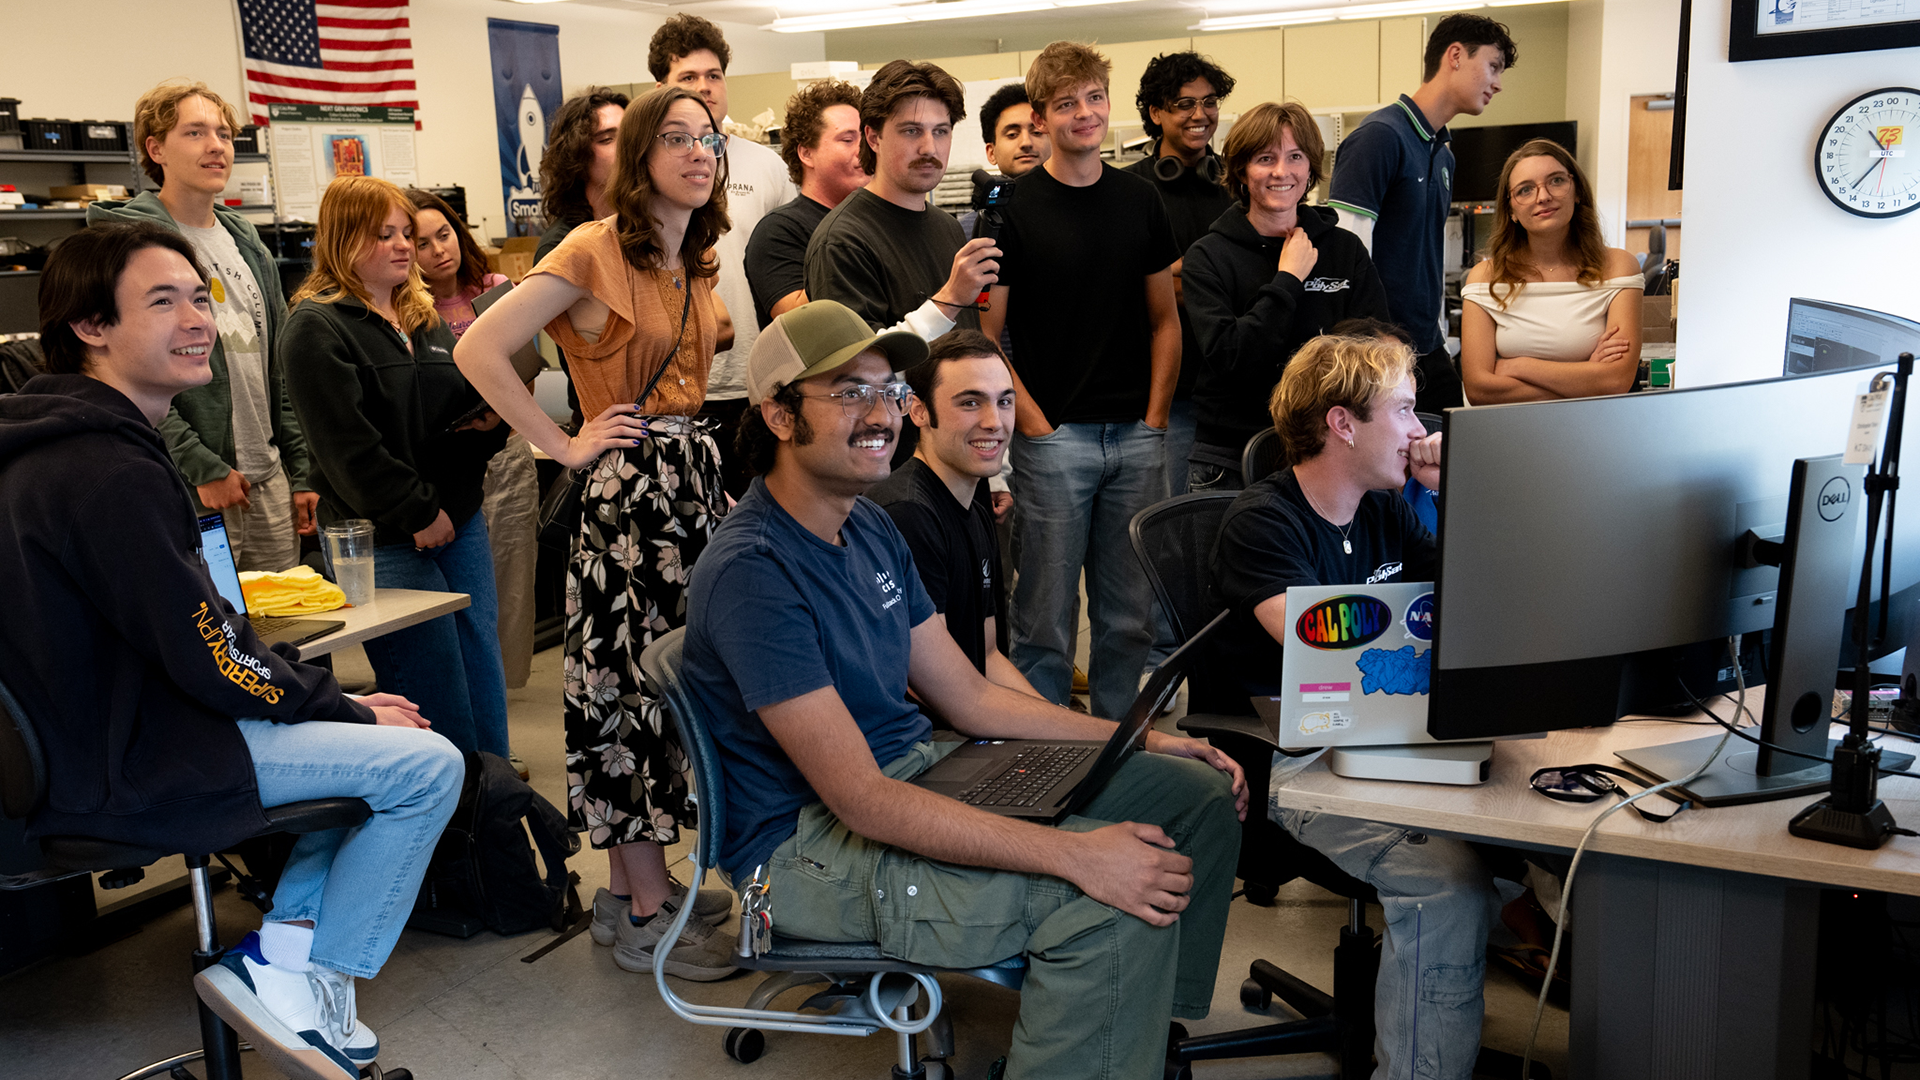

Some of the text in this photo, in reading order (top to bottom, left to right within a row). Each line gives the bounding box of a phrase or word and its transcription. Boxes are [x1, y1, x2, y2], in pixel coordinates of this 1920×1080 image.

[1873, 100, 1884, 108] 23
[1886, 97, 1899, 105] 00
[1858, 106, 1870, 114] 22
[1845, 115, 1854, 123] 21
[1834, 125, 1845, 133] 20
[1878, 127, 1901, 144] 73
[1826, 165, 1835, 173] 17
[1838, 186, 1847, 194] 15
[1849, 194, 1857, 202] 14
[1907, 193, 1917, 201] 10
[1861, 200, 1870, 208] 13
[1893, 199, 1901, 207] 11
[1821, 492, 1847, 507] DELL
[1409, 610, 1432, 622] NA
[1303, 601, 1382, 643] CAL POLY
